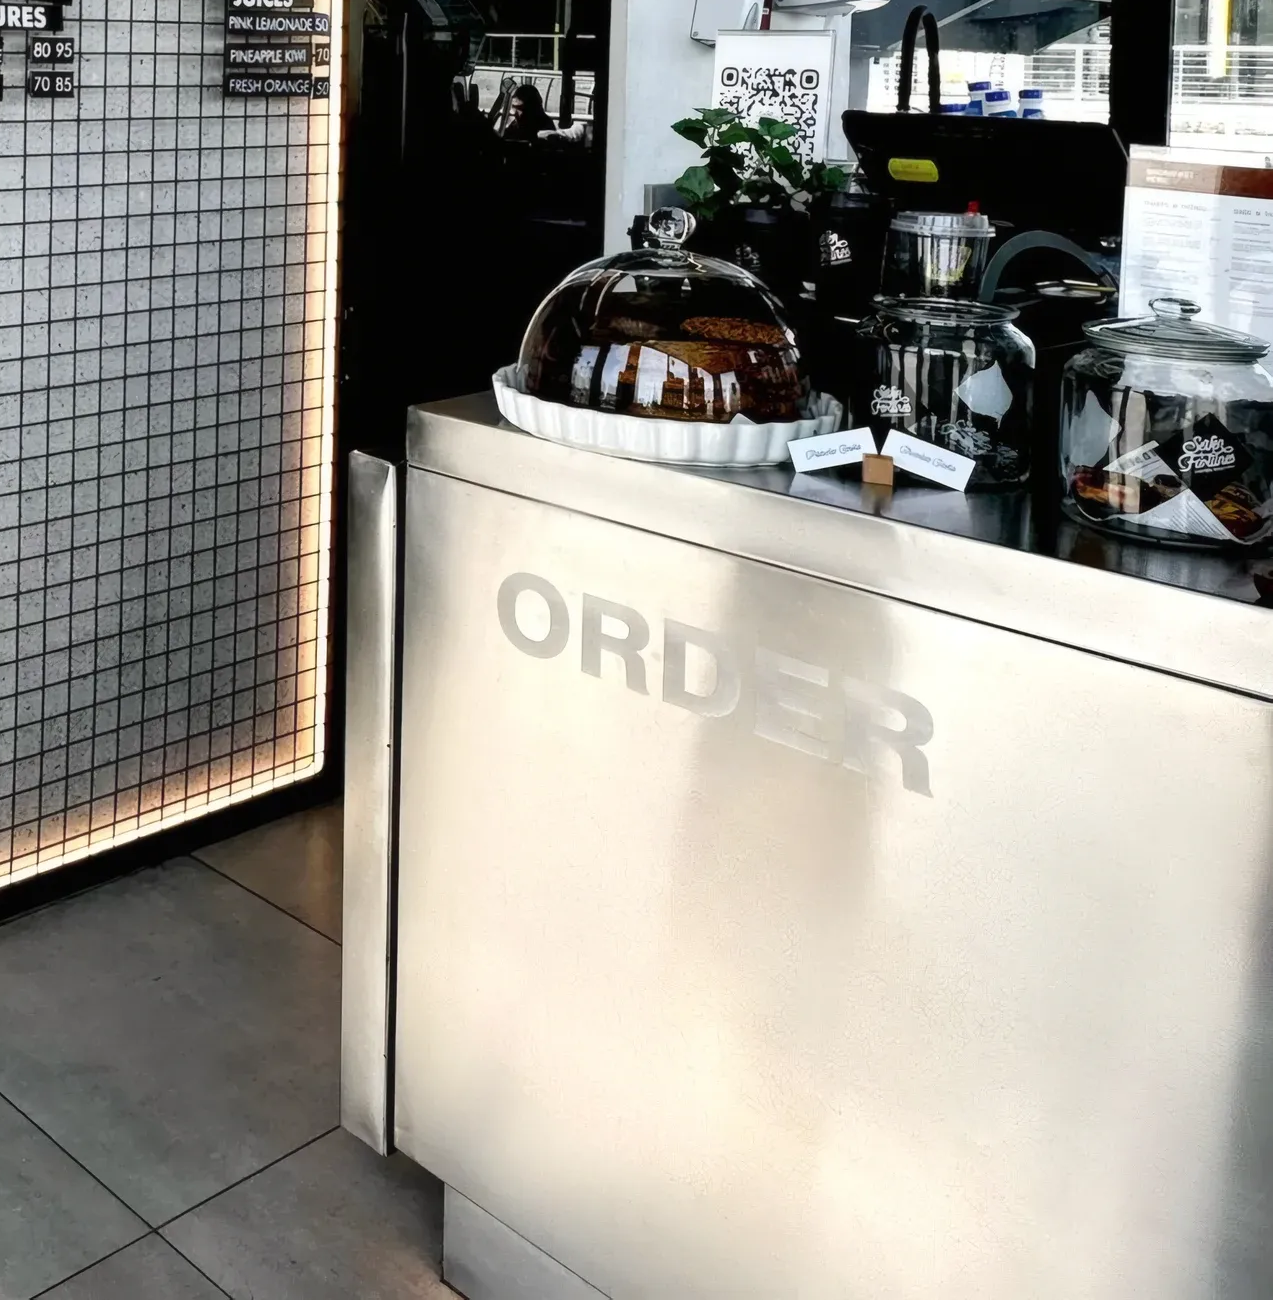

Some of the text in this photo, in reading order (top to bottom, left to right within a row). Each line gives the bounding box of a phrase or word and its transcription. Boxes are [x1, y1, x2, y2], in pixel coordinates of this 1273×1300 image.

[229, 17, 328, 31] PINK LEMONADE 50
[33, 42, 51, 58] 80
[55, 43, 72, 58] 95
[230, 49, 282, 63] PINEAPPLE
[316, 48, 329, 61] 70
[34, 77, 50, 91] 70
[55, 77, 72, 92] 85
[230, 79, 262, 92] FRESH
[264, 79, 309, 93] ORANGE
[497, 572, 933, 799] ORDER
